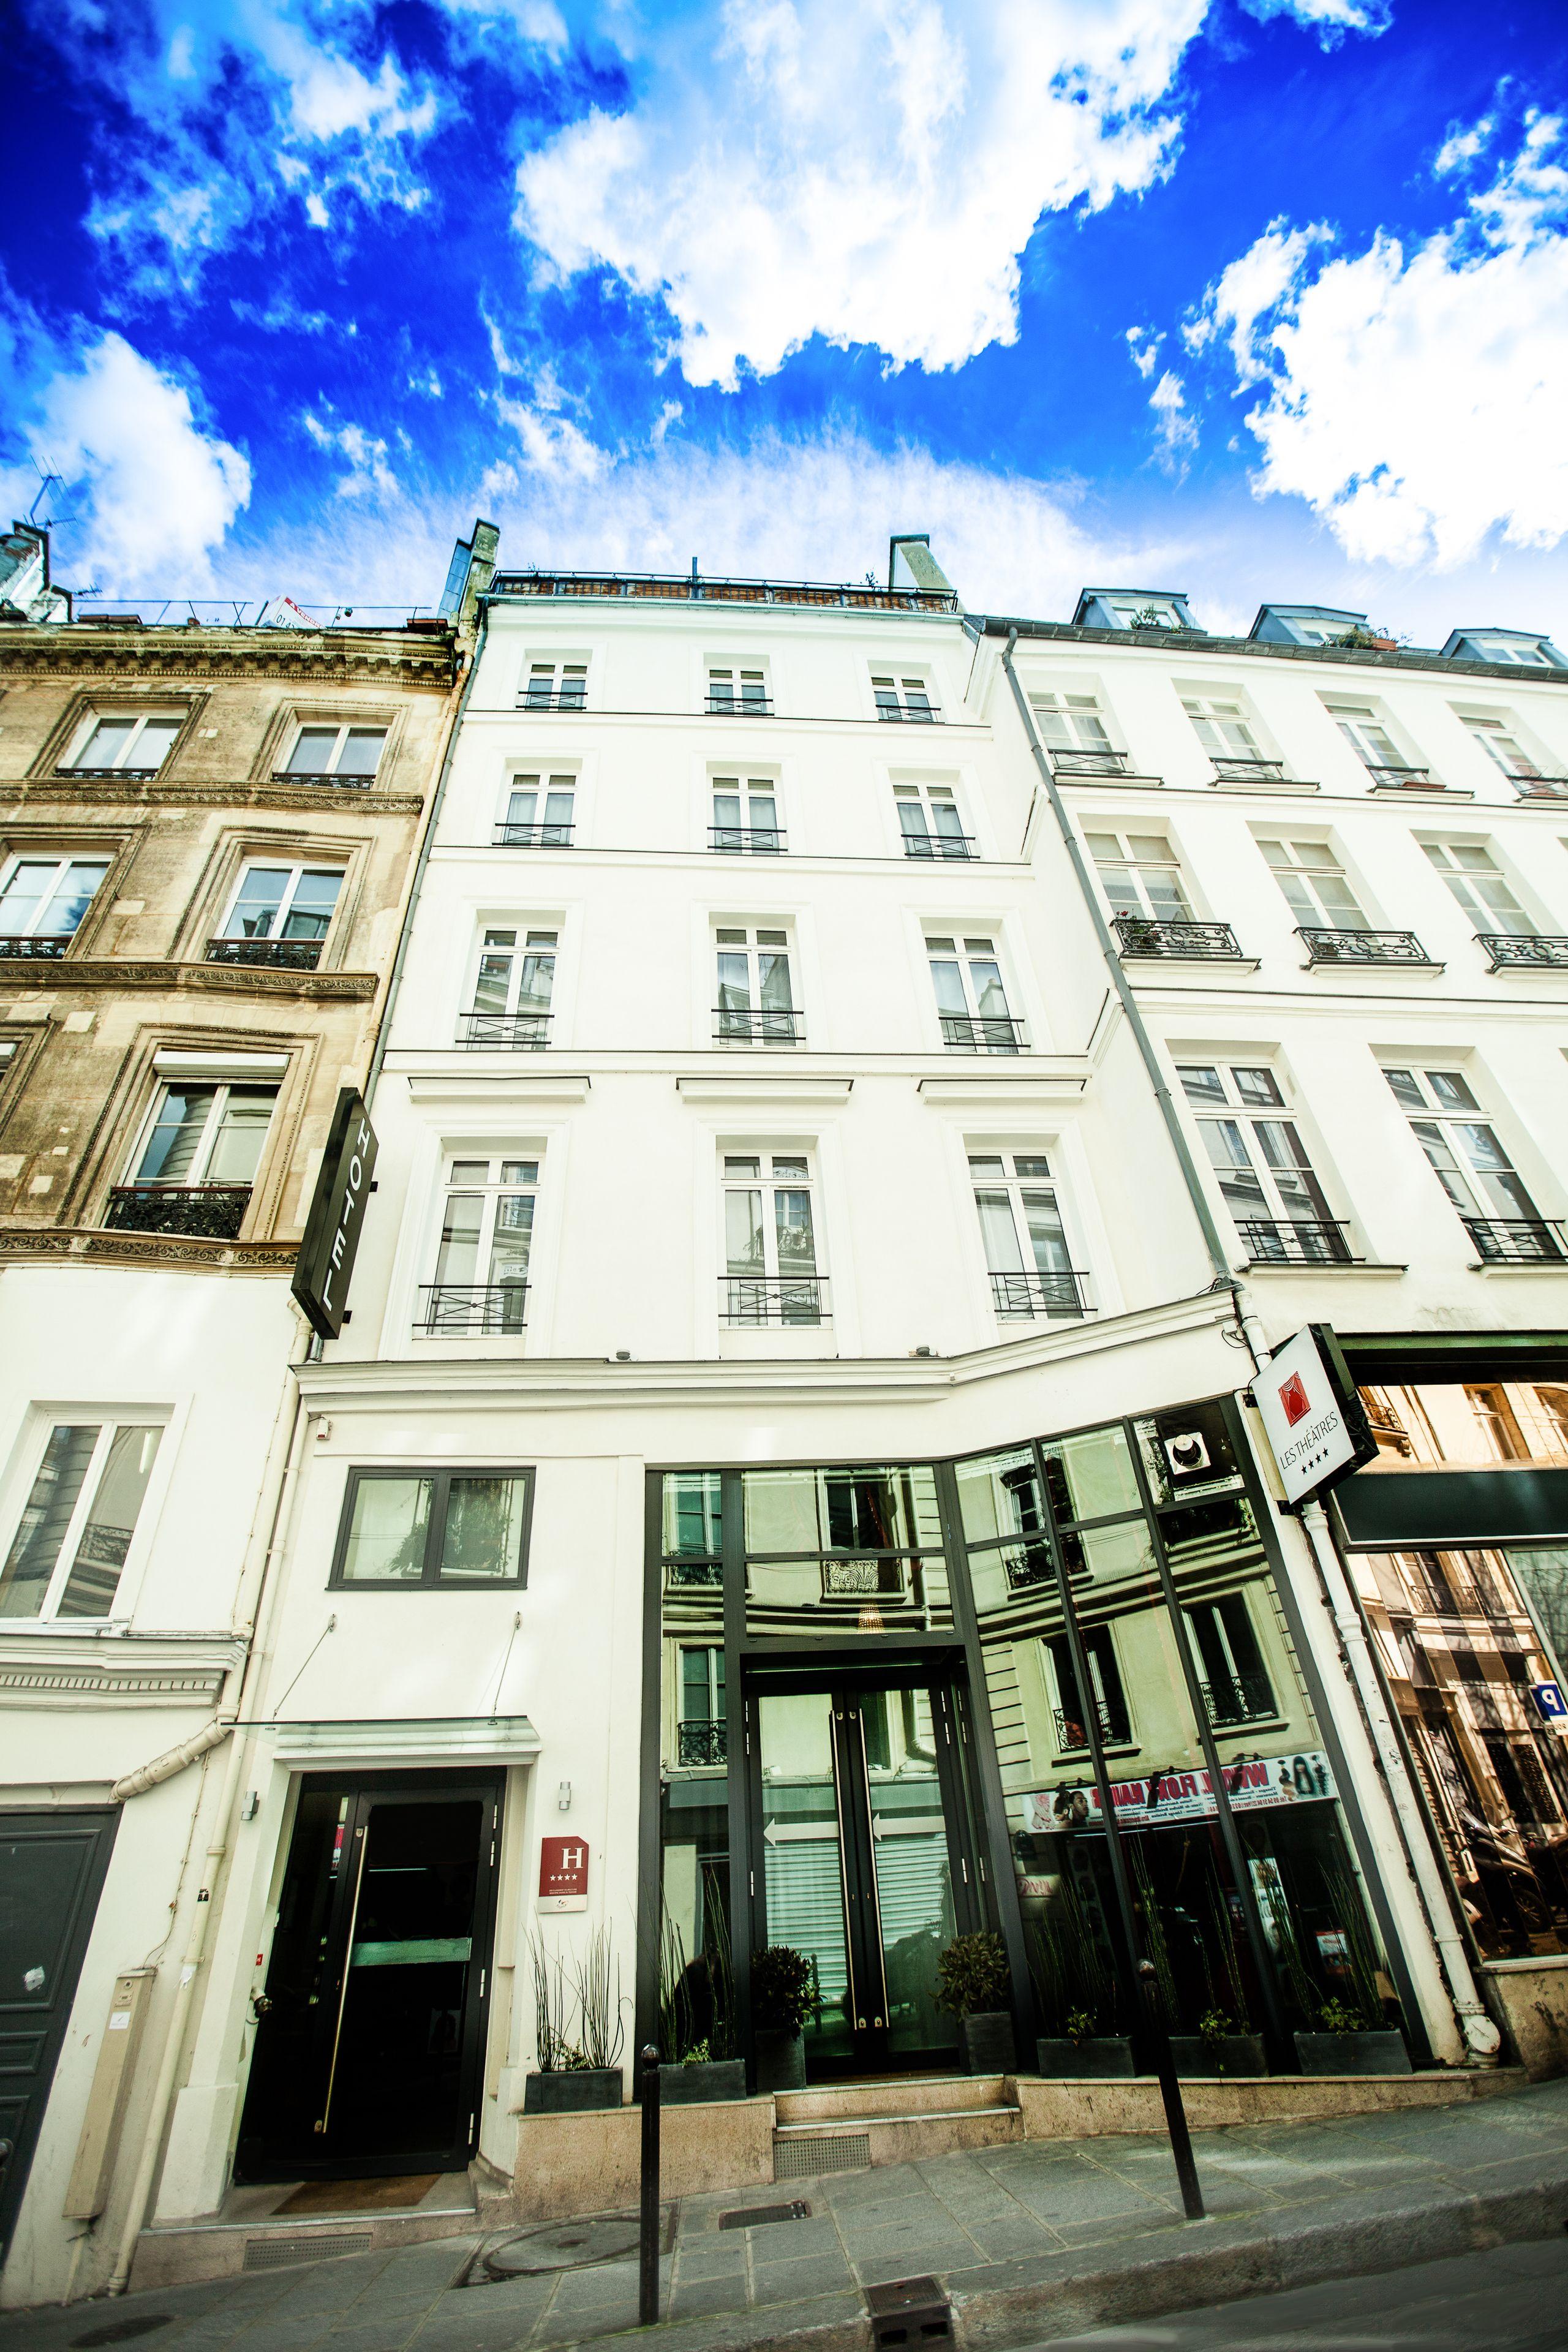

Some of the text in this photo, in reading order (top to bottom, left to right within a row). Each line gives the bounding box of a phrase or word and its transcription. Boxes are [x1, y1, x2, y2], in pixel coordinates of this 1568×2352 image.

[276, 614, 285, 626] 01
[296, 607, 322, 628] VENDR
[322, 1117, 371, 1312] HOTEL
[1280, 1411, 1338, 1469] LES THÉÂTRES
[560, 1847, 584, 1869] H
